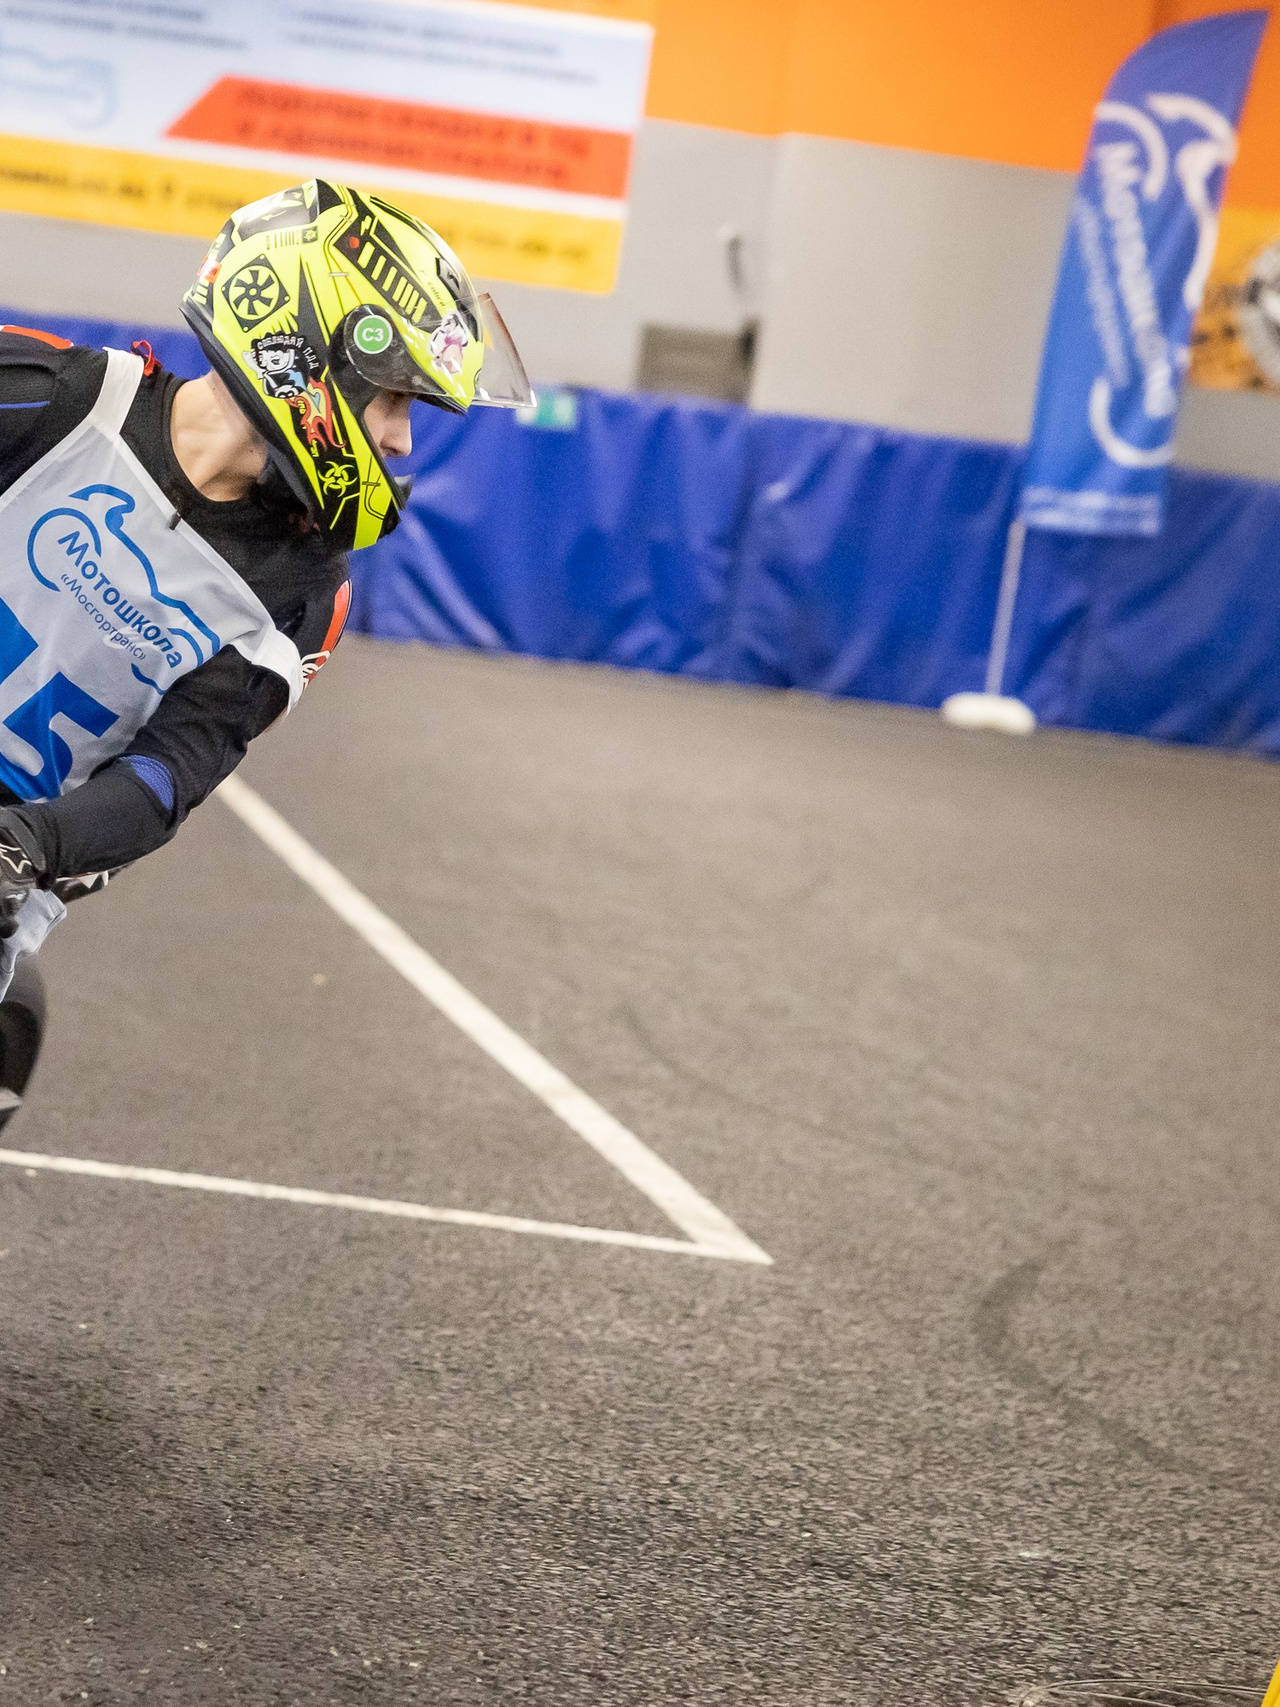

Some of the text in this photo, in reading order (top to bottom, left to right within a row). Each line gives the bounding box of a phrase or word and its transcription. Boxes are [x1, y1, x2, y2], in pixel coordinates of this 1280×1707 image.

[302, 347, 319, 369] ПДД
[57, 530, 183, 669] Мотошкола
[60, 573, 147, 661] «Мосгортранс»
